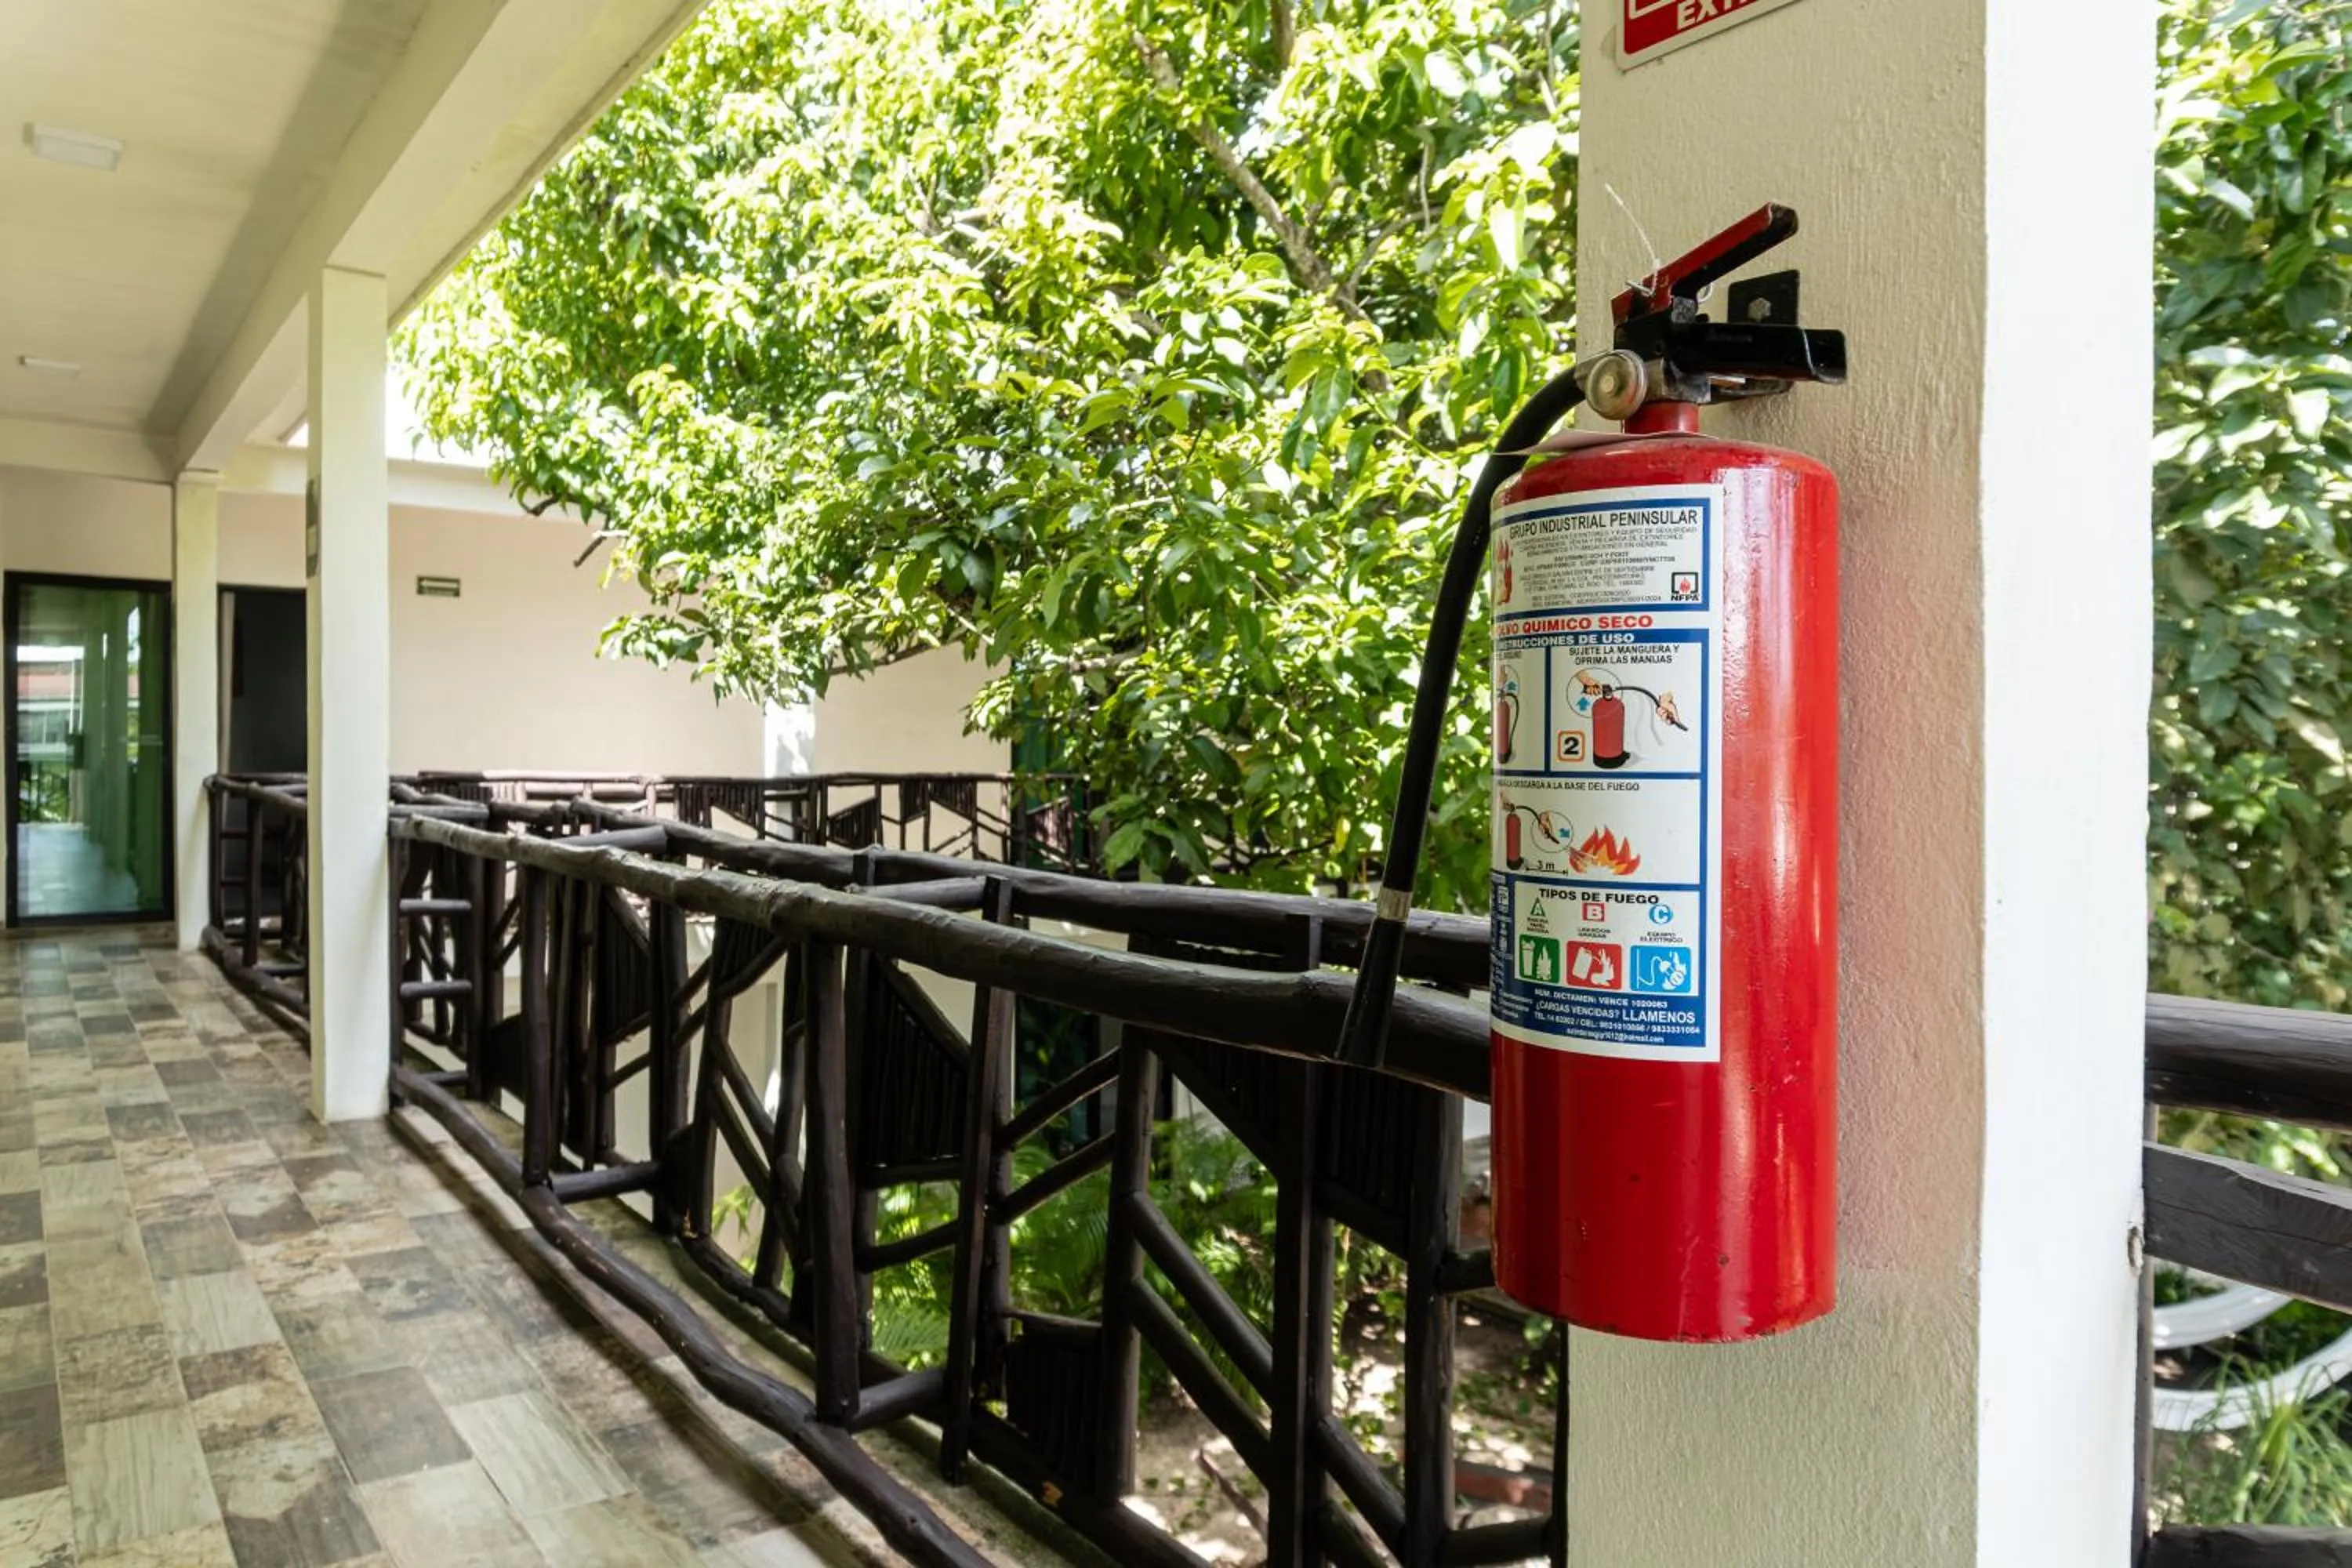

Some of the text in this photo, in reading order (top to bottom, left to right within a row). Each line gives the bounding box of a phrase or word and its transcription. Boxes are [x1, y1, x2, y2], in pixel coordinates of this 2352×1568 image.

[1509, 522, 1537, 539] GRUPO
[1539, 514, 1606, 533] INDUSTRIAL
[1610, 510, 1698, 528] PENINSULAR
[1523, 617, 1592, 633] QUIMICO
[1598, 615, 1653, 628] SECO
[1578, 634, 1599, 644] DE
[1602, 633, 1635, 644] USO
[1569, 644, 1680, 656] SUJETE LA MANGUERA Y
[1575, 655, 1672, 666] OPRIMA LAS MANIJAS
[1563, 736, 1580, 755] 2
[1565, 782, 1586, 791] BASE
[1588, 782, 1605, 792] DEL
[1607, 782, 1640, 792] FUEGO
[1537, 859, 1545, 869] 3
[1539, 887, 1660, 905] TIPOS DE FUEGO
[1585, 904, 1603, 920] B
[1653, 905, 1671, 924] C
[1599, 996, 1628, 1007] VENCE
[1570, 1006, 1621, 1018] VENCIDAS?
[1622, 1008, 1696, 1024] LLAMENOS
